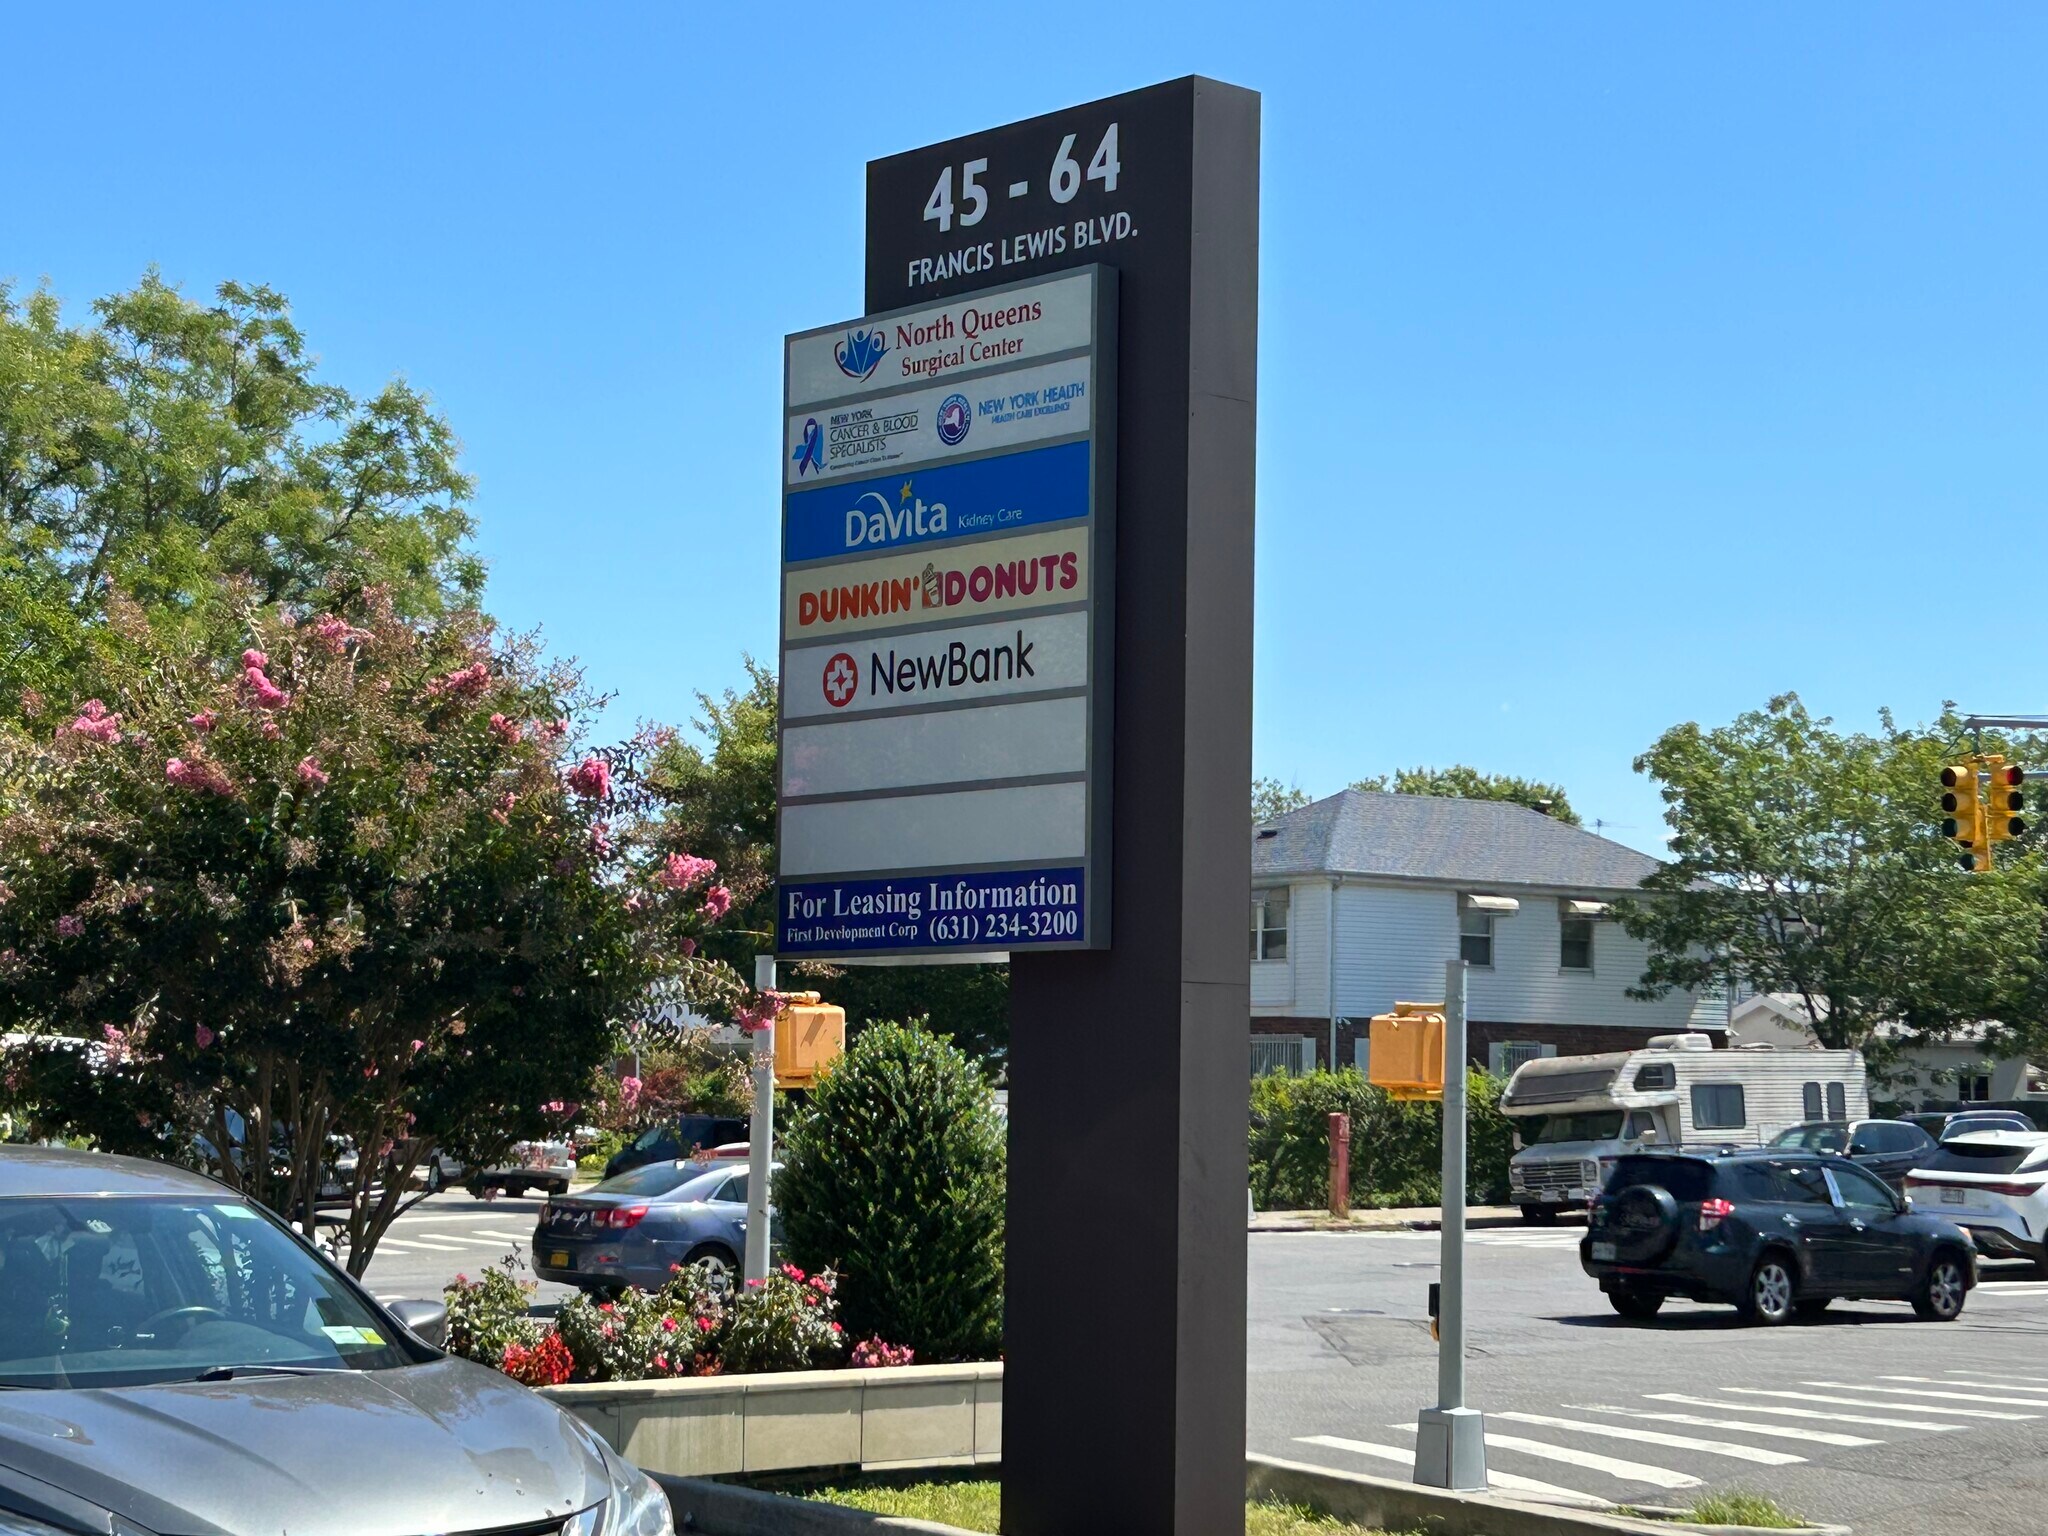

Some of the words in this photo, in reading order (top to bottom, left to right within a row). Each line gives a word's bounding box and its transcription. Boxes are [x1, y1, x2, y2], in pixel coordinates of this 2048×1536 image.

[923, 157, 989, 233] 45
[1049, 122, 1121, 204] 64
[908, 242, 994, 287] FRANCIS
[1001, 225, 1066, 267] LEWIS
[1074, 211, 1138, 250] BLVD.
[896, 314, 953, 350] North
[962, 301, 1042, 339] Queens
[901, 344, 965, 377] Surgical
[970, 338, 1024, 363] Center
[978, 397, 1005, 417] NEW
[1009, 390, 1040, 410] YORK
[1043, 381, 1085, 402] HEALTH
[830, 424, 869, 442] CANCER
[872, 421, 880, 434] &
[883, 415, 918, 432] BLOOD
[830, 437, 886, 460] SPECIALISTS
[845, 491, 947, 547] DaVita
[958, 513, 995, 529] Kidney
[997, 508, 1023, 522] Care
[799, 575, 920, 626] DUNKIN'
[944, 551, 1078, 606] DONUTS
[870, 630, 1035, 696] NewBank
[787, 891, 827, 920] For
[833, 885, 922, 920] Leasing
[928, 877, 1078, 911] Information
[787, 927, 812, 943] First
[815, 924, 886, 943] Development
[888, 921, 918, 940] Corp
[928, 914, 979, 943] (631)
[985, 910, 1078, 938] 234-3200
